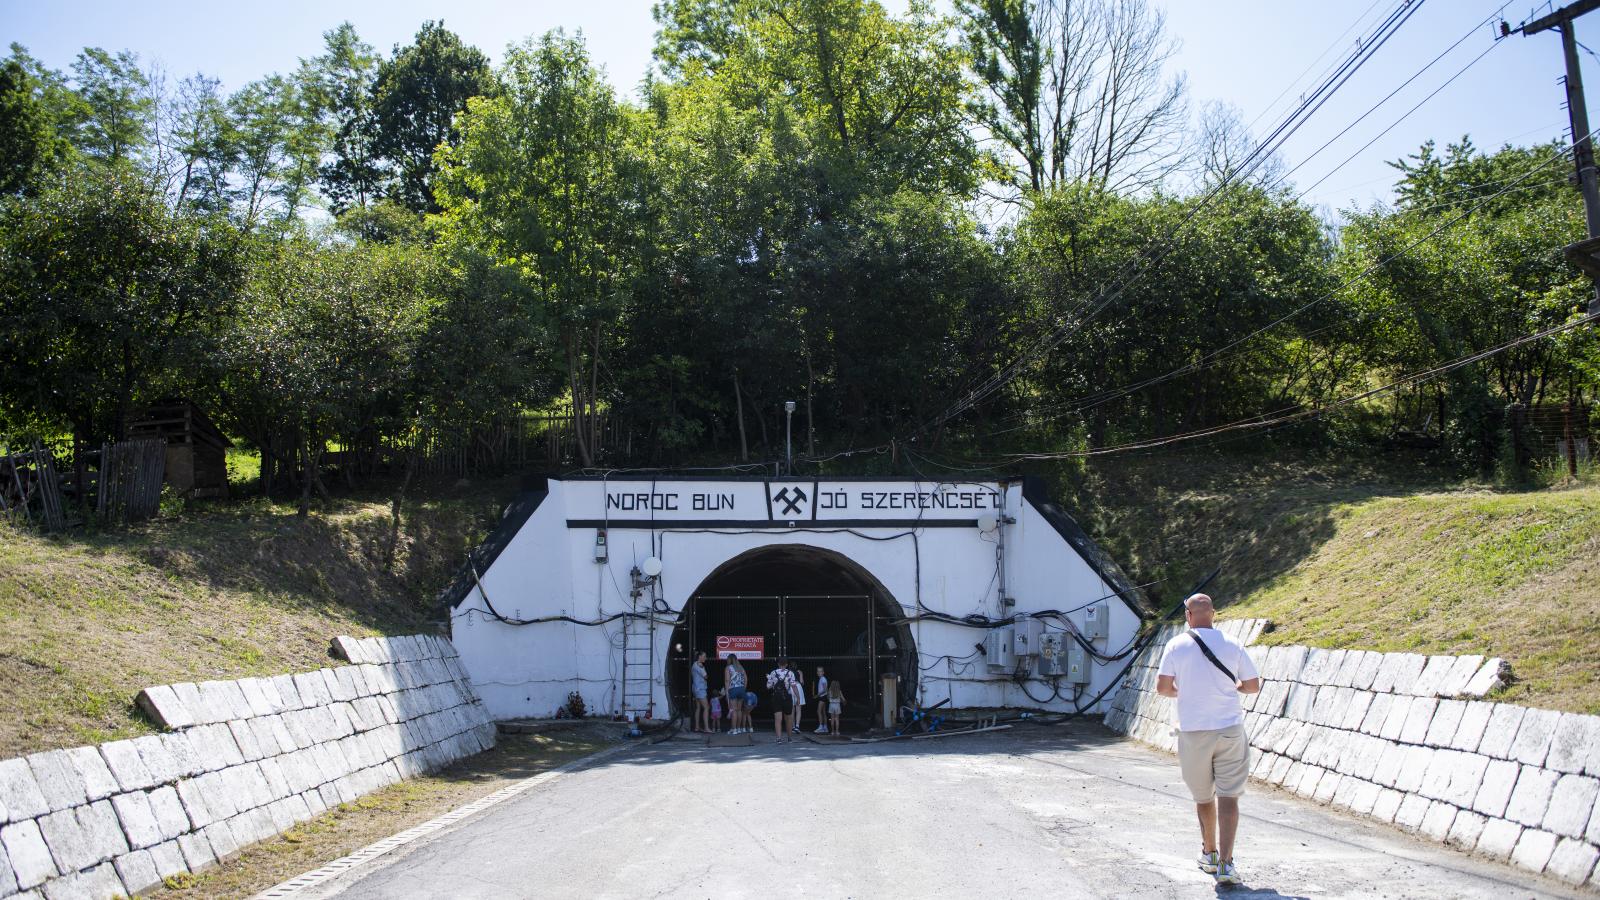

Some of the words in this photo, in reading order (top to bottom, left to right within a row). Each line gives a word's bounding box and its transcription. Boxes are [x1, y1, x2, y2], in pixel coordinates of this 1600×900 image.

[607, 493, 678, 510] NOROC
[692, 493, 734, 510] BUN
[821, 487, 848, 509] JÓ
